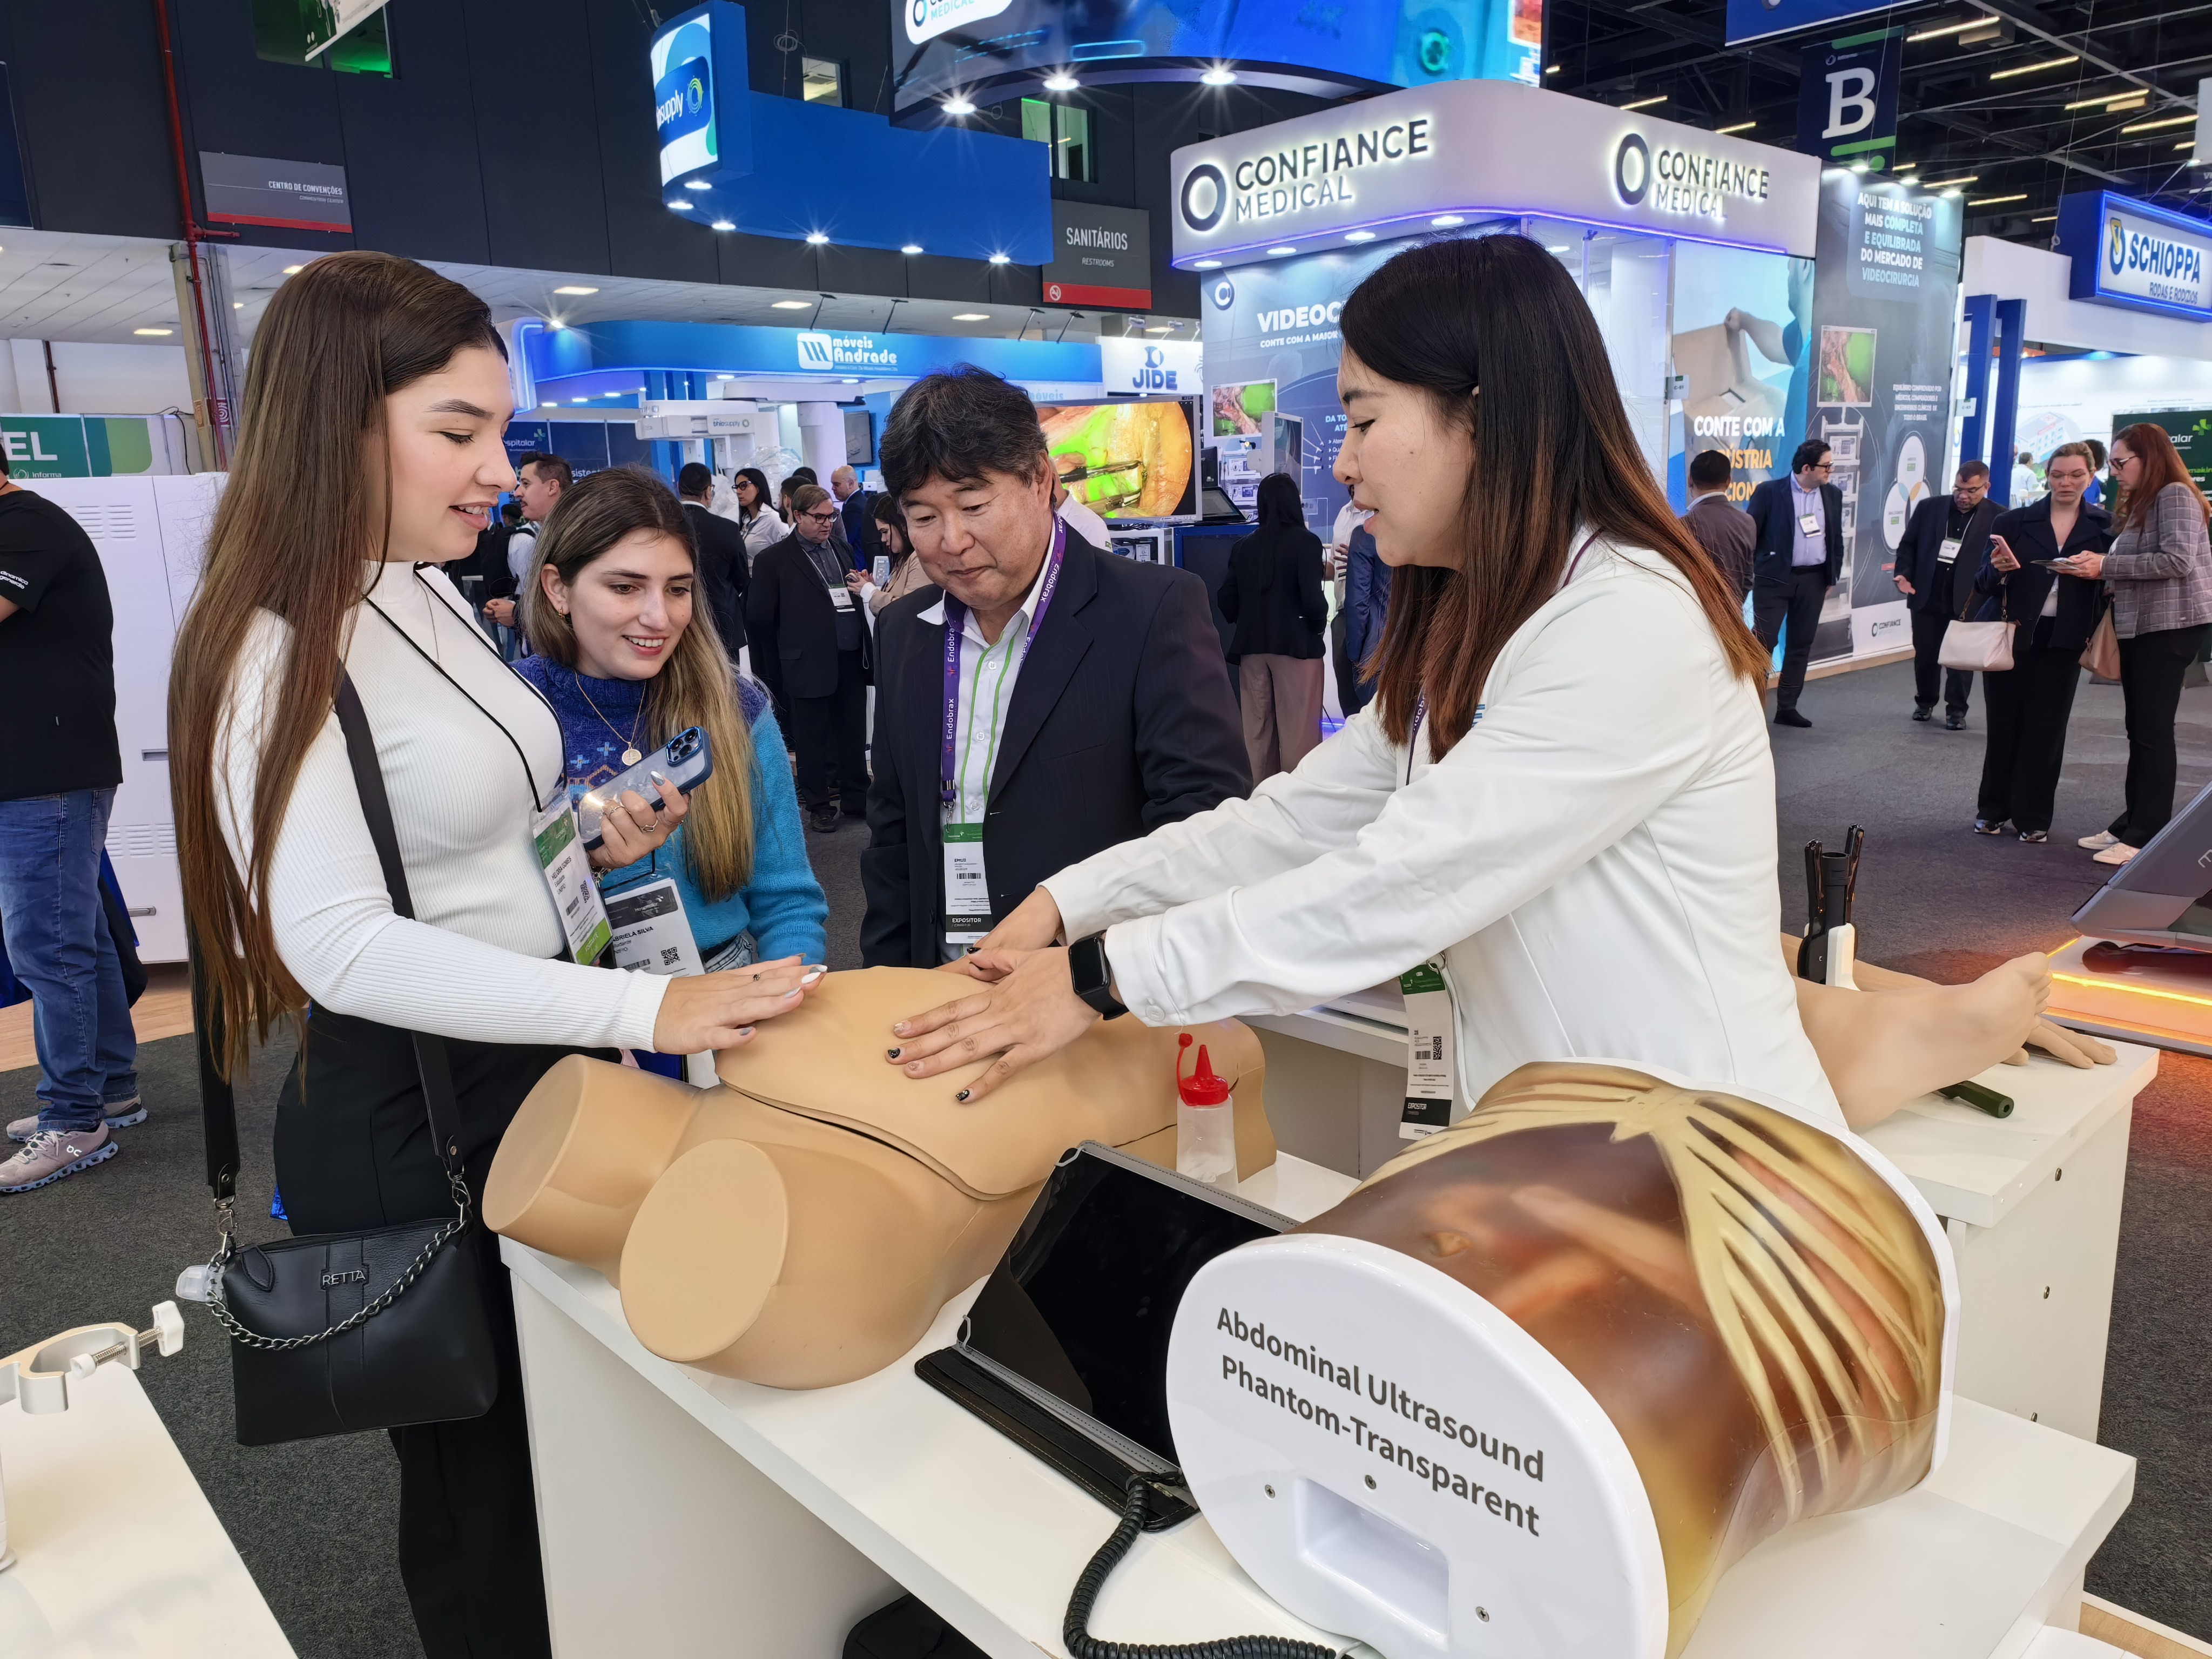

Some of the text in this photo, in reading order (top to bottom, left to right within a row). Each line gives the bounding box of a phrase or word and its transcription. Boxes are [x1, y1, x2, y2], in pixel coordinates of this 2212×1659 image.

[1822, 67, 1875, 139] B
[1236, 119, 1428, 191] CONFIANCE
[1658, 150, 1769, 199] CONFIANCE
[268, 181, 293, 190] CENTRO
[303, 185, 342, 195] CONVENÇÕES
[1236, 176, 1353, 222] MEDICAL
[1655, 184, 1728, 219] MEDICAL
[1857, 192, 1932, 220] AQUI TEM A SOLUÇÃO
[1865, 212, 1924, 235] MAIS COMPLETA
[1067, 226, 1128, 250] SANITÁRIOS
[1864, 231, 1921, 253] E EQUILIBRADA
[1082, 257, 1115, 267] RESTROOMS
[1860, 248, 1923, 270] DO MERCADO DE
[2129, 233, 2200, 284] SCHIOPPA
[1862, 267, 1919, 287] VIDEOCIRURGIA
[2149, 282, 2168, 298] RODAS
[2169, 287, 2173, 300] E
[833, 335, 873, 349] móveis
[1260, 330, 1338, 348] CONTE COM A MAIOR
[834, 347, 898, 364] Andrade
[1132, 369, 1177, 390] JIDE
[1694, 415, 1785, 437] CONTE COM A
[2168, 434, 2193, 443] alar
[1702, 442, 1772, 469] ÚSTRIA
[1040, 563, 1060, 602] Endobrax
[637, 926, 653, 935] SILVA
[322, 1270, 366, 1285] RETTA
[1217, 1307, 1543, 1482] Abdominal Ultrasound
[1223, 1354, 1540, 1537] Phantom-Transparent
